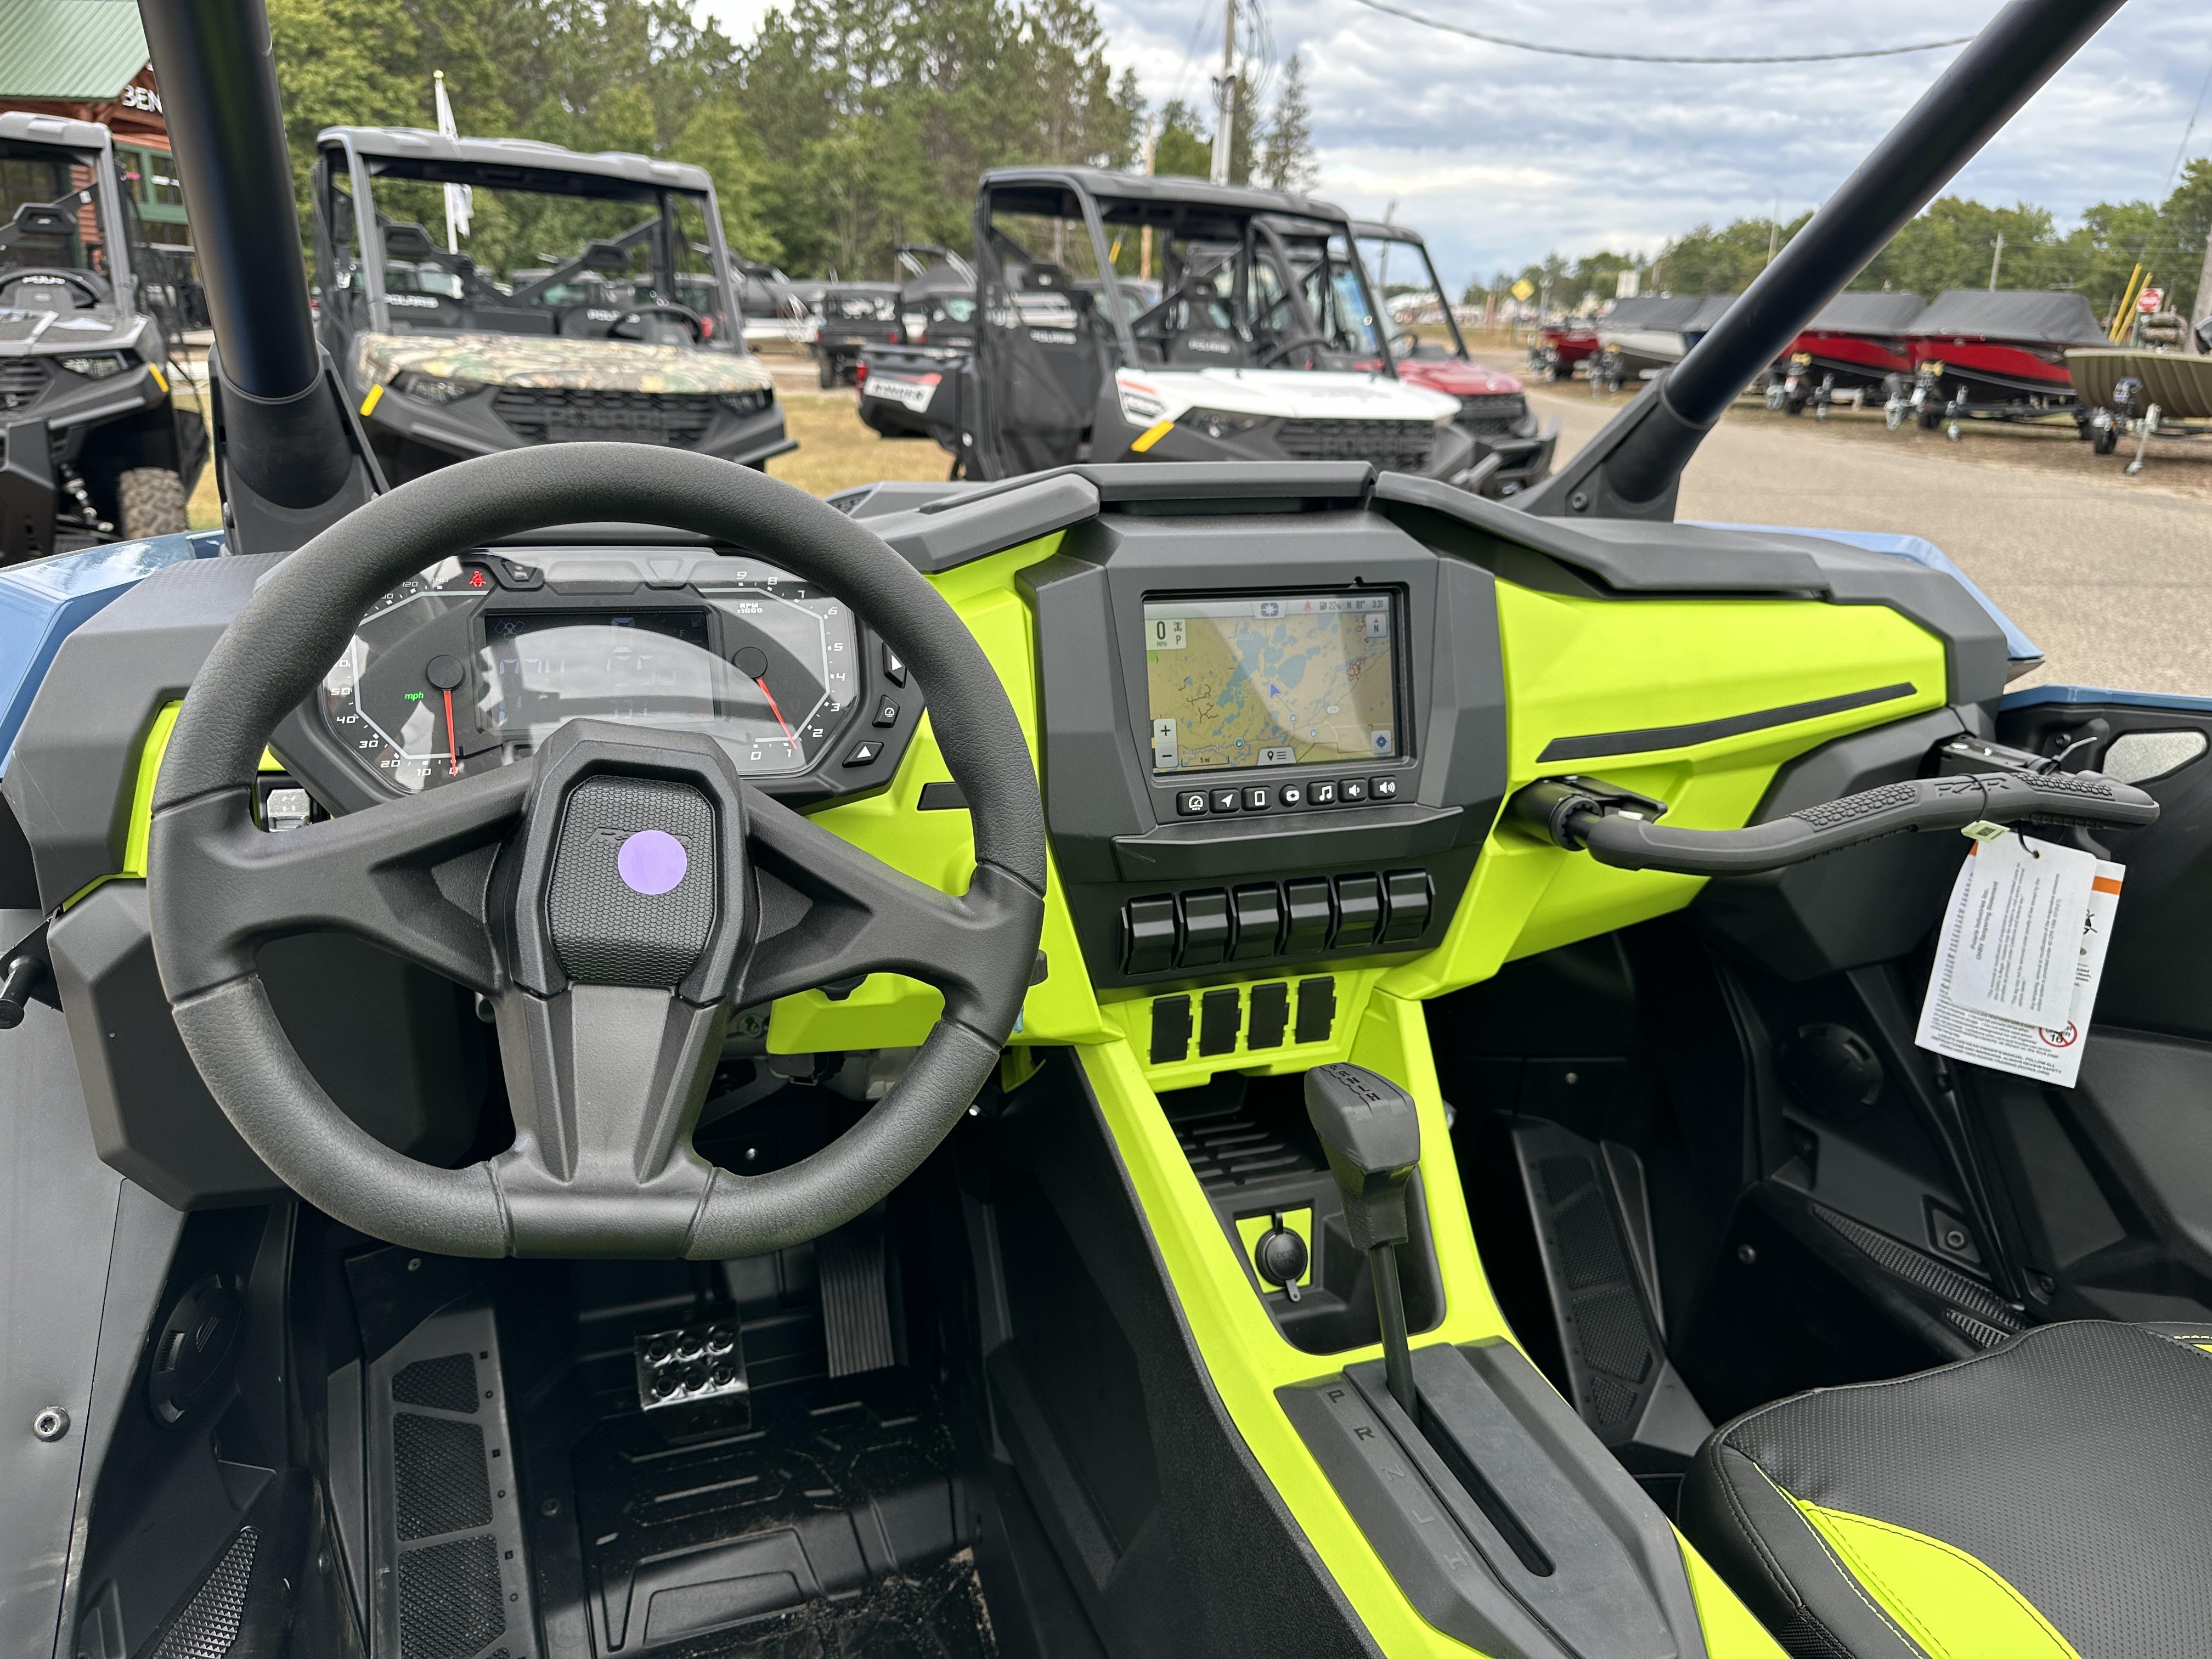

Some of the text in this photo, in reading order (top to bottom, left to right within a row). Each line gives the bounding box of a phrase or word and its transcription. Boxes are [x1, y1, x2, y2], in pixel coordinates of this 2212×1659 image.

[737, 571, 747, 580] 9
[768, 577, 778, 585] 8
[798, 590, 805, 599] 7
[828, 606, 838, 615] 6
[1156, 621, 1166, 640] 0
[1374, 624, 1379, 633] N
[1176, 635, 1181, 645] P
[833, 642, 844, 651] 5
[836, 673, 845, 681] 4
[331, 687, 351, 696] 50
[404, 692, 424, 701] mph
[831, 703, 840, 712] 3
[336, 716, 357, 724] 40
[812, 729, 823, 737] 2
[359, 740, 379, 748] 30
[751, 751, 761, 760] 0
[787, 749, 792, 758] 1
[380, 760, 400, 768] 20
[1365, 1092, 1381, 1101] H
[1327, 1389, 1469, 1571] P R N L H
